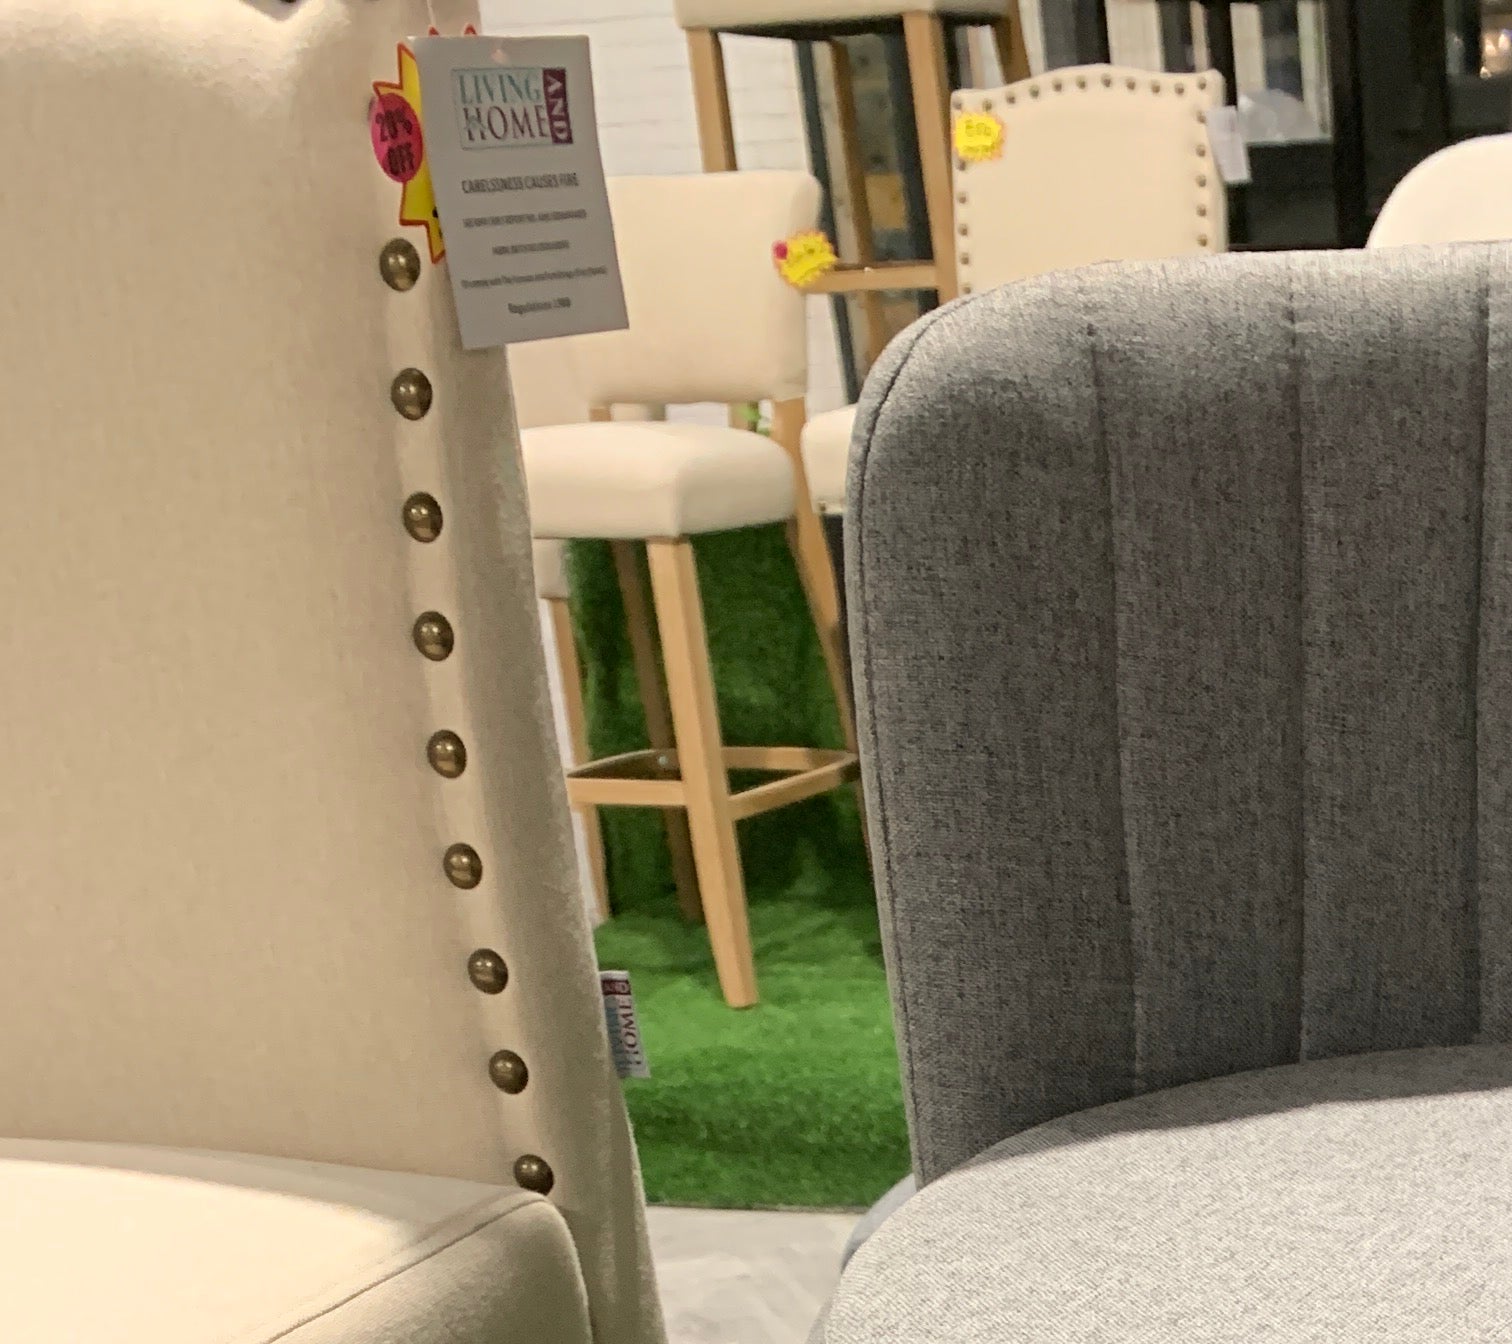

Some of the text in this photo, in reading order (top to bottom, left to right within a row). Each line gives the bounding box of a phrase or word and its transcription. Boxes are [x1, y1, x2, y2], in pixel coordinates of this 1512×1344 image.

[459, 74, 541, 104] LIVING
[463, 105, 550, 142] HOME
[546, 75, 569, 141] AND
